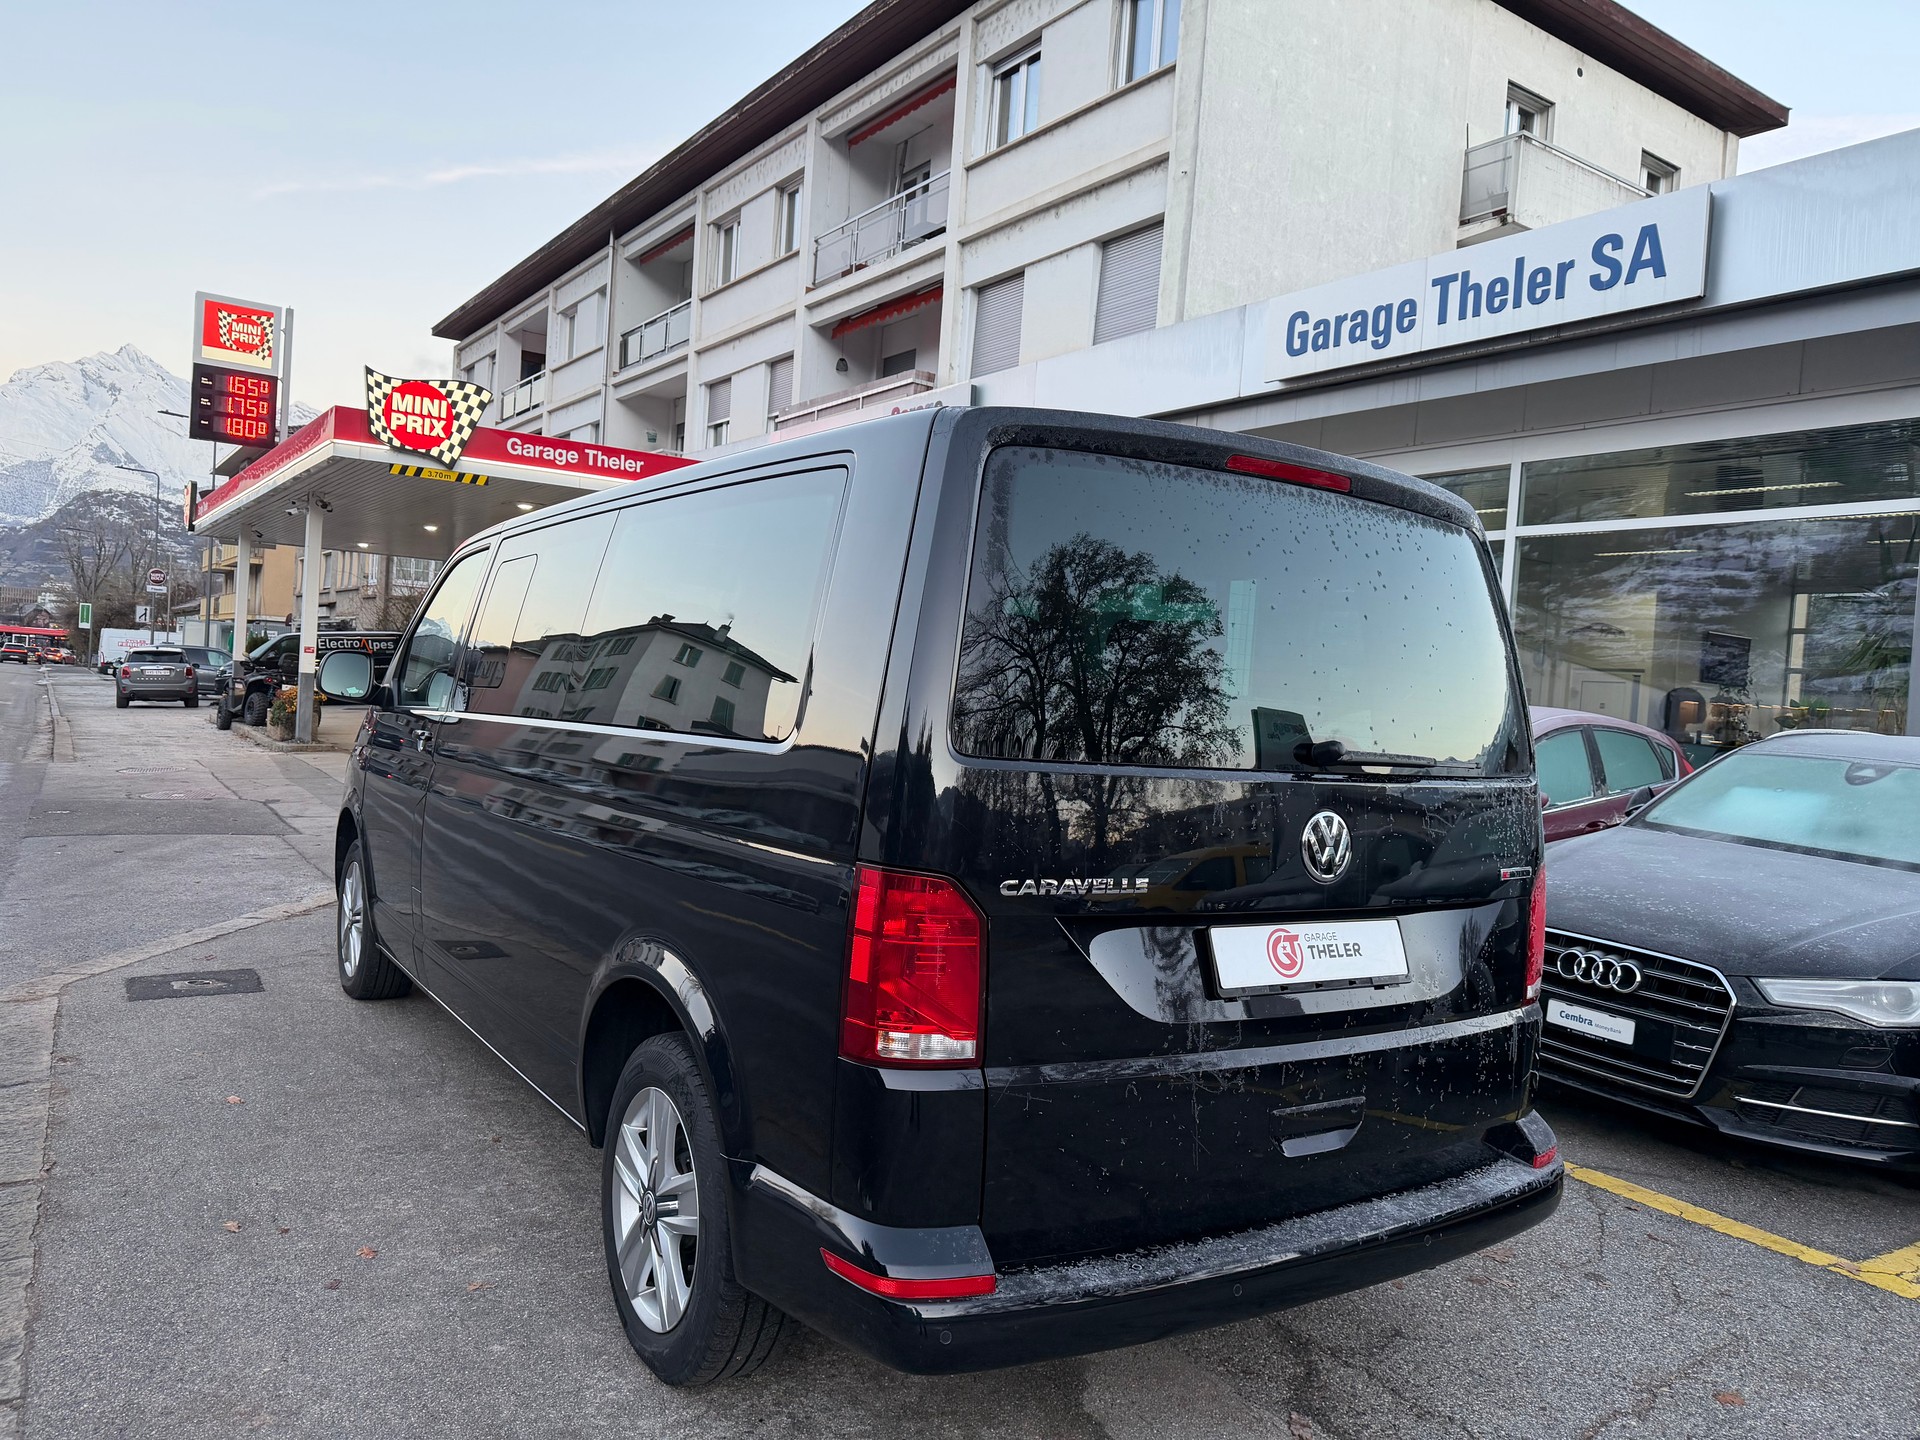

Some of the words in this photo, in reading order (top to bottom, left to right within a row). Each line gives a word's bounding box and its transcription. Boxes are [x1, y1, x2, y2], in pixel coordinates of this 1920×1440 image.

[1285, 296, 1418, 357] Garage
[1431, 256, 1576, 326] Theler
[1589, 222, 1667, 292] SA
[231, 321, 262, 336] MINI
[231, 331, 262, 346] PRIX
[391, 391, 448, 419] MINI
[390, 411, 447, 439] PRIX
[506, 437, 579, 466] Garage
[585, 448, 645, 473] Theler
[999, 877, 1150, 897] CARAVELLE
[1303, 931, 1338, 943] GARAGE
[1306, 942, 1363, 960] THELER
[1559, 1010, 1593, 1027] Cembra
